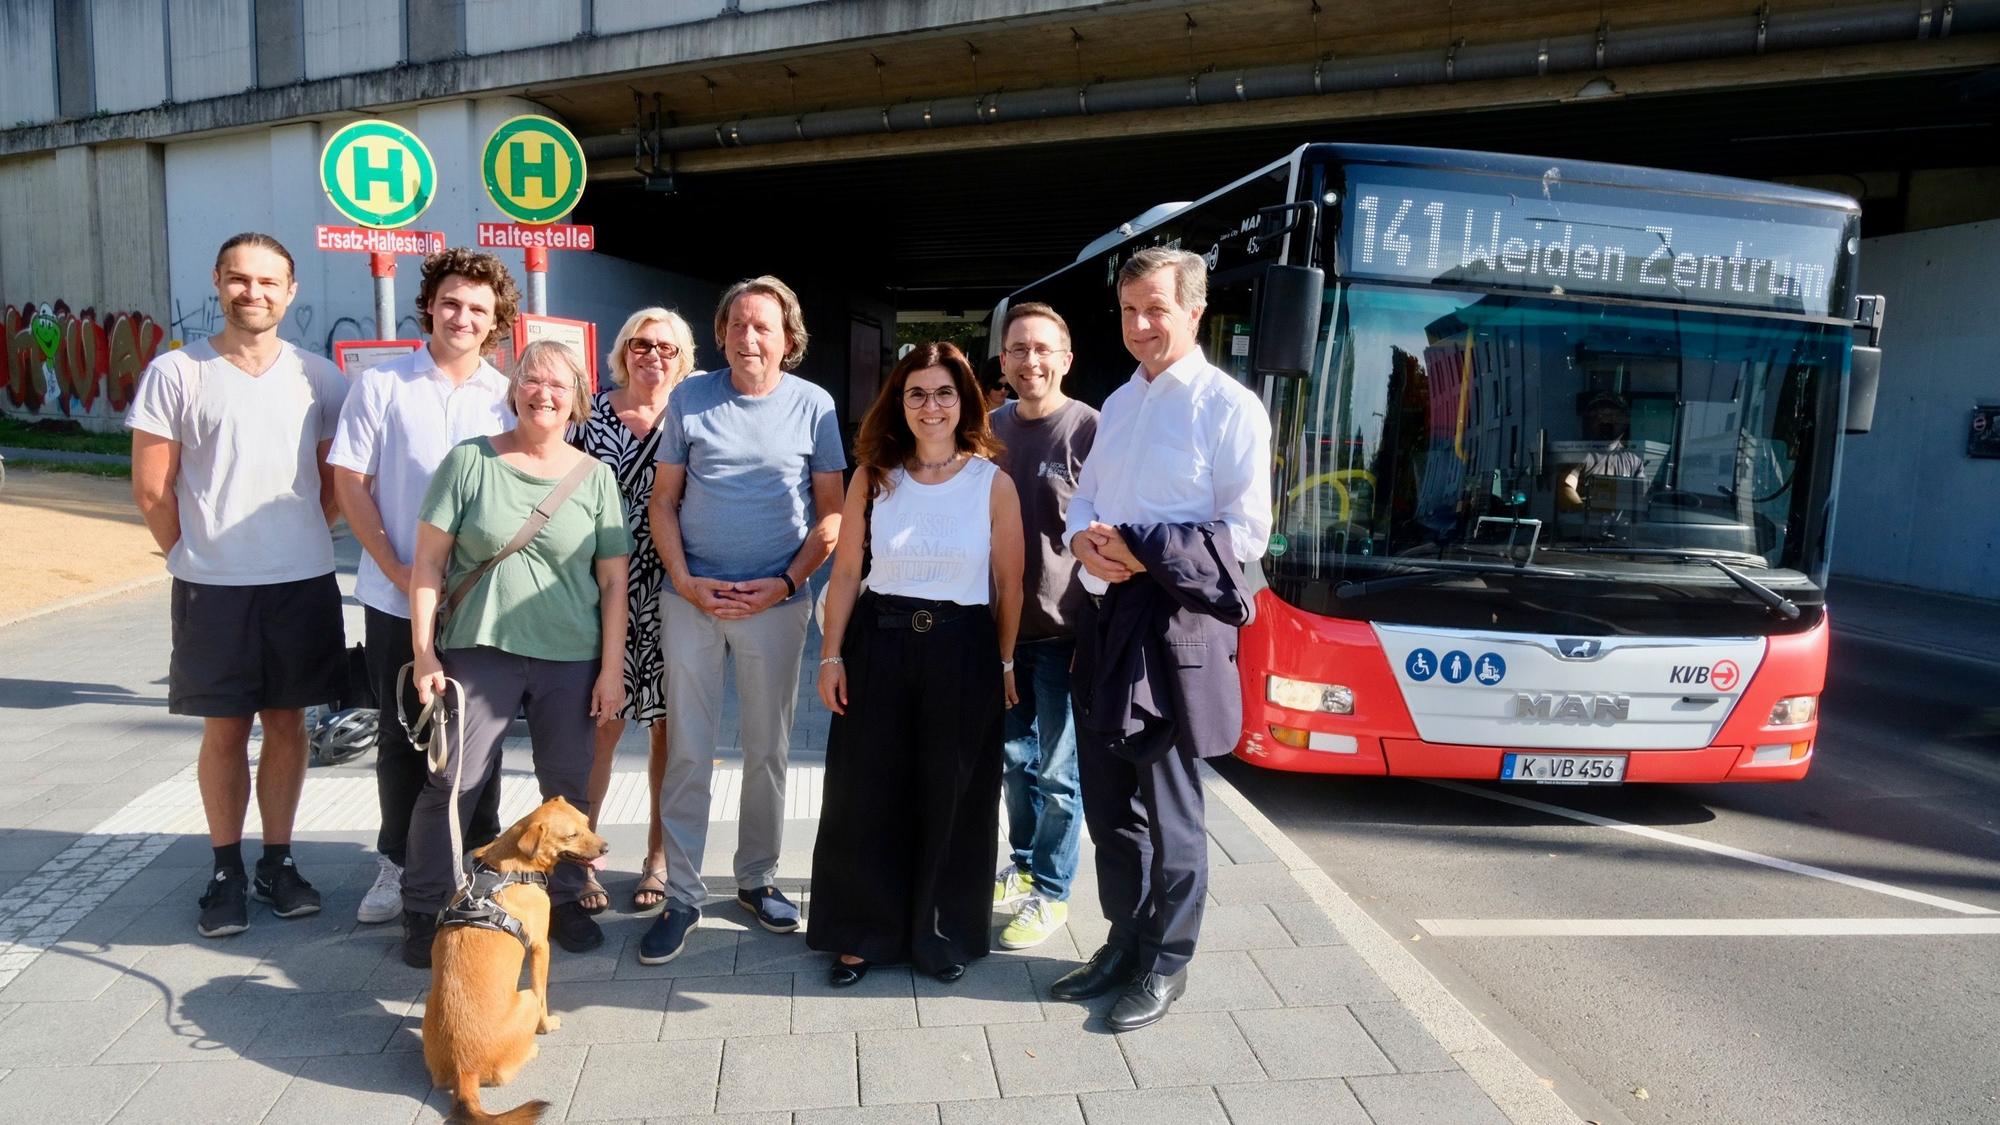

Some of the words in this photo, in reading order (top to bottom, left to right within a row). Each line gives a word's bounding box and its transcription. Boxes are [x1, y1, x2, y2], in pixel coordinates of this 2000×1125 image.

[353, 146, 404, 203] H
[509, 142, 556, 198] H
[318, 228, 442, 253] Ersatz-Haltestelle
[479, 224, 590, 248] Haltestelle
[1358, 195, 1443, 269] 141
[1461, 208, 1626, 281] Weiden
[1639, 225, 1825, 298] Zentrum
[1669, 665, 1710, 684] KVB
[1516, 692, 1631, 721] MAN
[1521, 758, 1536, 776] K
[1551, 758, 1575, 777] VB
[1579, 759, 1614, 778] 456
